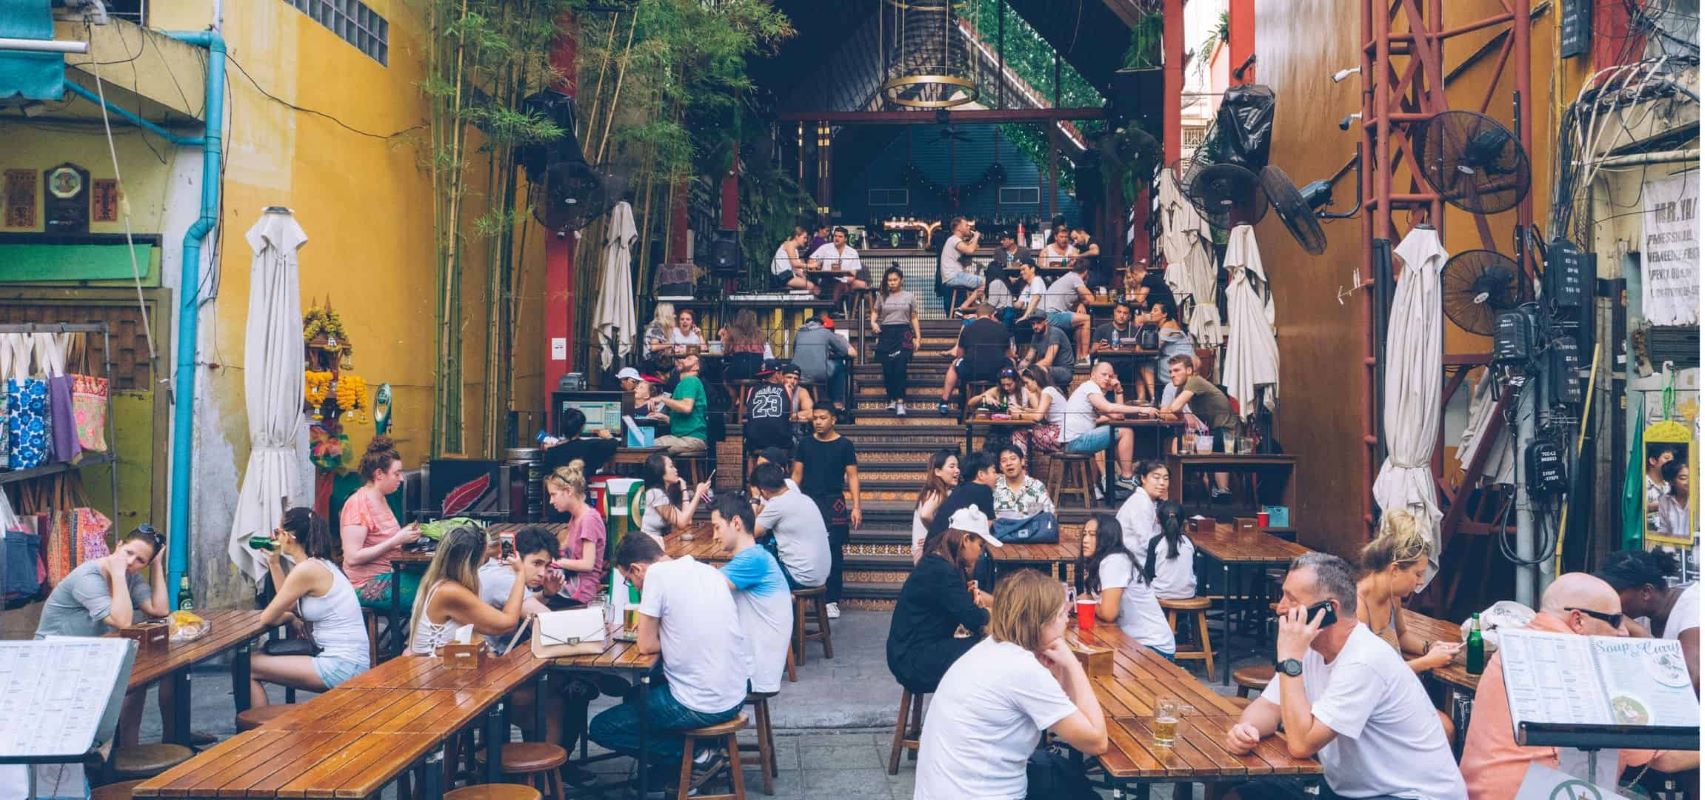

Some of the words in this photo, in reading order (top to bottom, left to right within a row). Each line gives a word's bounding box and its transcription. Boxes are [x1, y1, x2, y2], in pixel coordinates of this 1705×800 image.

[753, 394, 782, 418] 23
[1595, 640, 1629, 655] Soup
[1636, 640, 1681, 659] Curry
